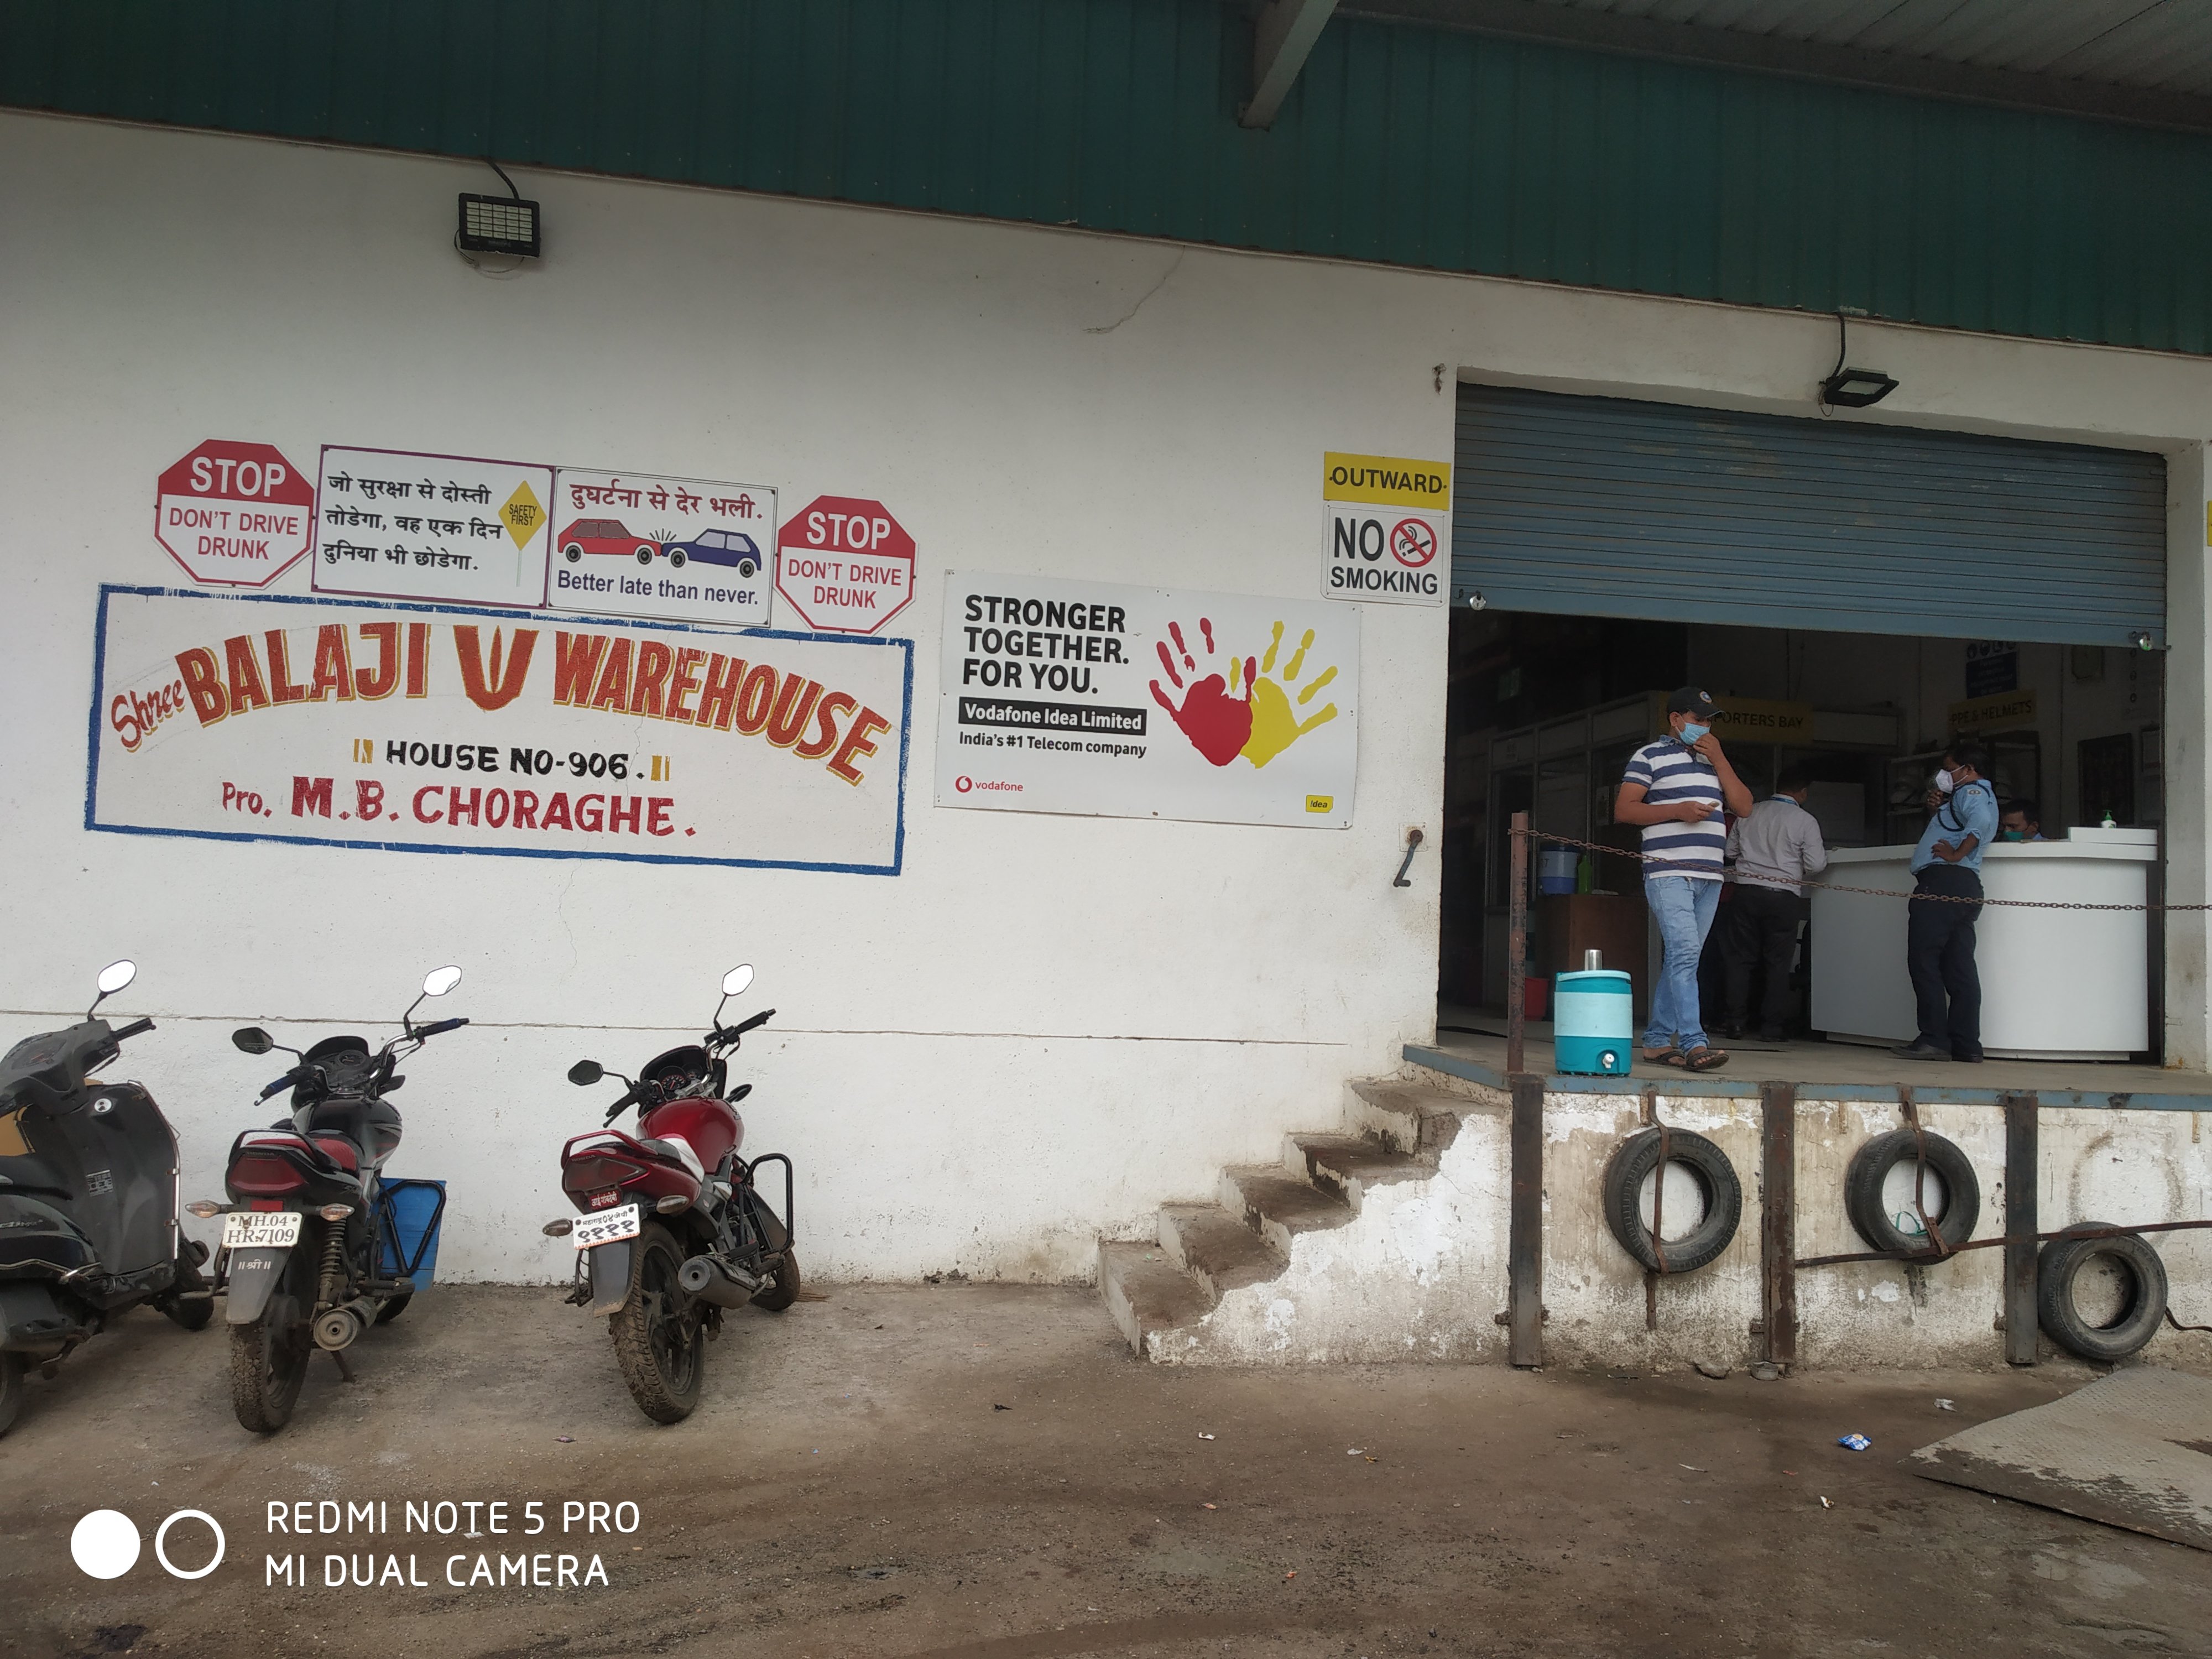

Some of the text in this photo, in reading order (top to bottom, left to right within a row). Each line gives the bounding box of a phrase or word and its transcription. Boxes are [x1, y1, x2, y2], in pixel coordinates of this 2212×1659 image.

[190, 456, 286, 497] STOP
[327, 471, 493, 504] जो सुरक्षा से दोस्ती
[1332, 466, 1442, 494] OUTWARD
[509, 503, 538, 517] SAFETY
[646, 484, 670, 510] से
[674, 486, 703, 515] देर
[709, 493, 763, 519] भली.
[169, 507, 299, 535] DON'T DRIVE
[324, 504, 504, 540] तोडेगा, वह एक दिन
[511, 514, 534, 526] FIRST
[806, 510, 891, 550] STOP
[197, 535, 270, 560] DRUNK
[1334, 517, 1385, 561] NO
[322, 539, 479, 571] दुनिया भी छोडेगा.
[557, 570, 759, 605] Better late than never.
[788, 559, 902, 586] DON'T DRIVE
[1330, 566, 1438, 595] SMOKING
[813, 586, 877, 609] DRUNK
[964, 594, 1125, 633] STRONGER
[963, 625, 1129, 665] TOGETHER.
[963, 658, 1098, 695] FOR YOU.
[111, 622, 892, 787] Shree BALAJI WAREHOUSE
[964, 702, 1142, 730] Vodafone Idea Limited
[1981, 700, 2032, 721] HELMETS
[1778, 716, 1804, 729] BAY
[386, 739, 499, 773] HOUSE
[959, 731, 1147, 759] India's #1 Telecom company
[975, 780, 1024, 791] vodafone
[222, 781, 273, 818] Pro.
[412, 785, 697, 837] CHORAGHE.
[237, 1215, 288, 1227] MH.04
